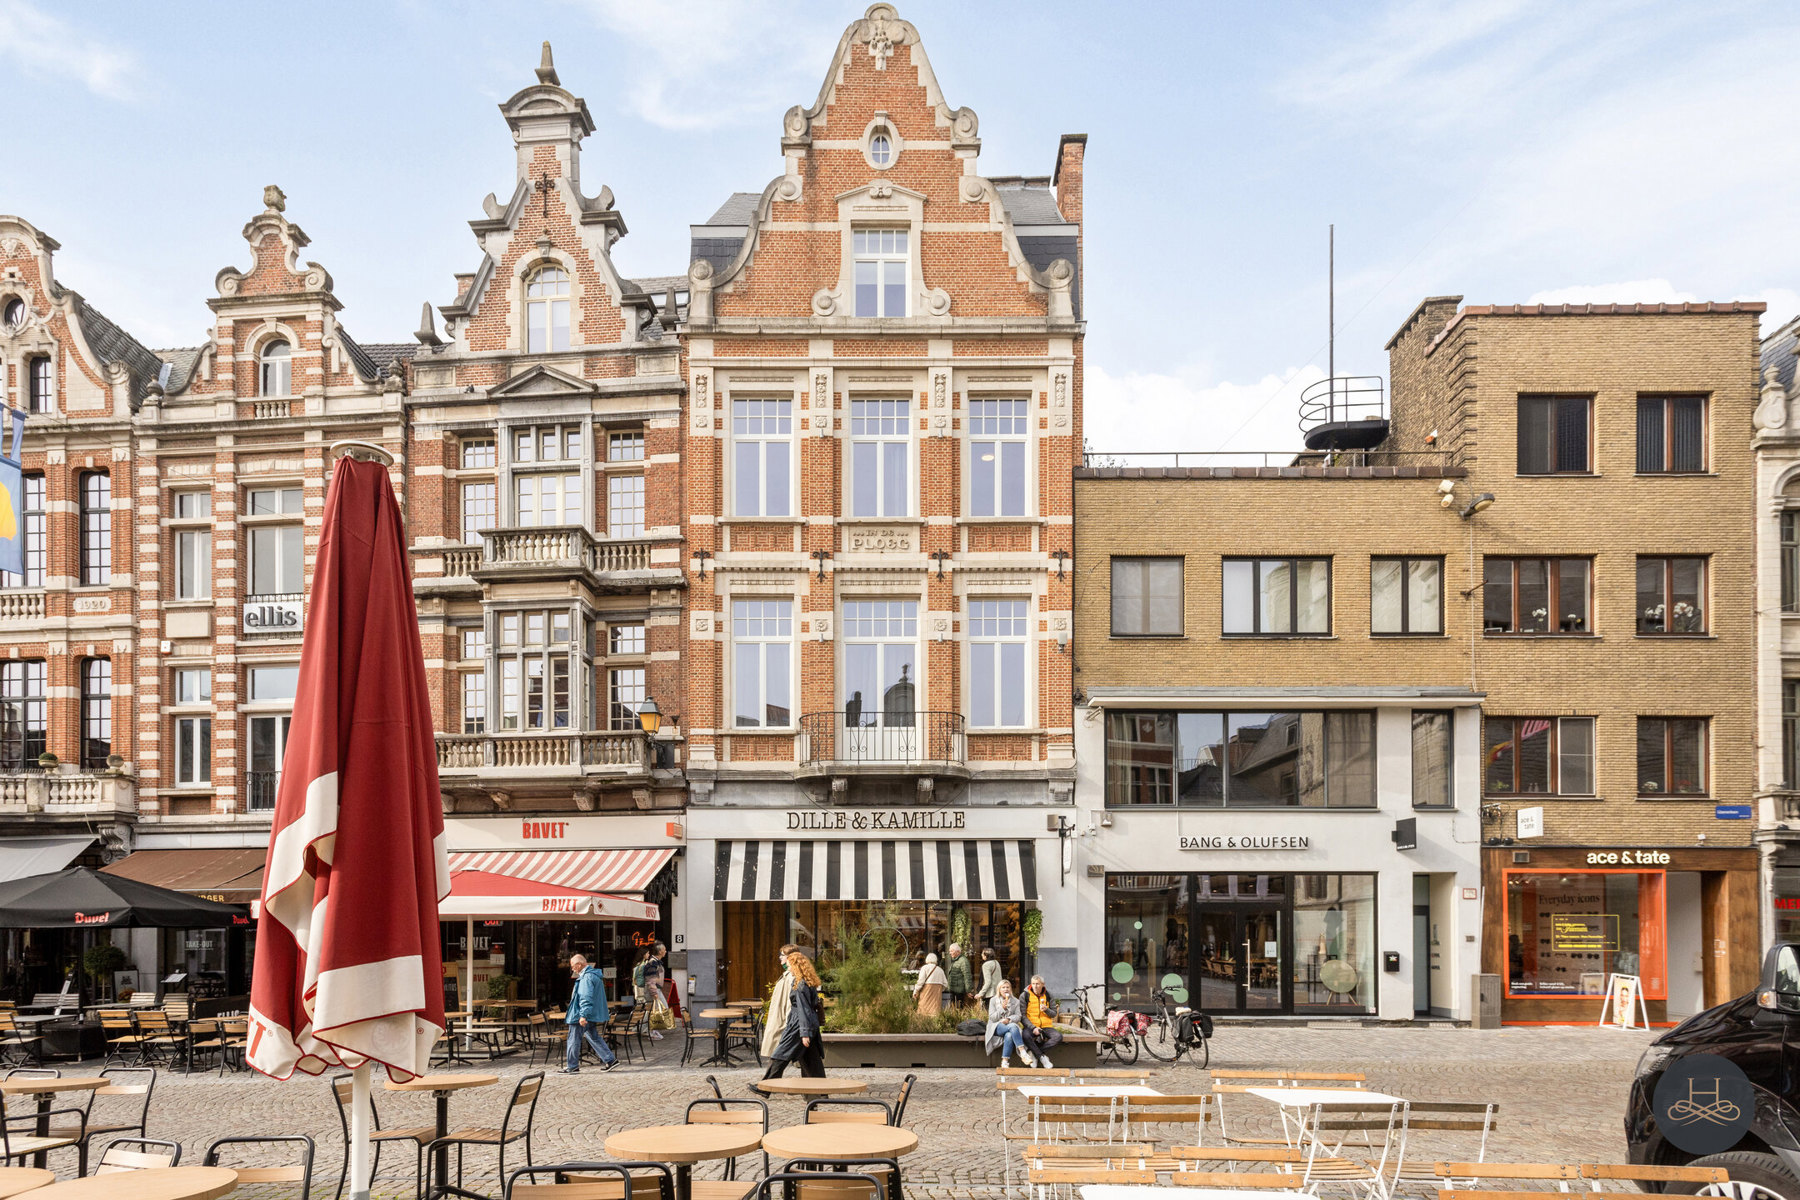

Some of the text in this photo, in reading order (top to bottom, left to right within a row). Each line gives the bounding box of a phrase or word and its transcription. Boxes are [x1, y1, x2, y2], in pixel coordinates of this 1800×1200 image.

[852, 538, 909, 550] PLOEG
[245, 605, 297, 628] ellis
[787, 811, 965, 830] DILLE & KAMILLE
[522, 822, 565, 839] BAVET
[1180, 836, 1308, 848] BANG & OLUFSEN
[1587, 850, 1671, 864] ace & tate
[542, 898, 578, 913] BAVET
[1540, 893, 1600, 906] Everyday icons
[74, 911, 110, 924] Duvel
[185, 940, 213, 949] TAKE-OUT
[460, 936, 490, 950] BVET
